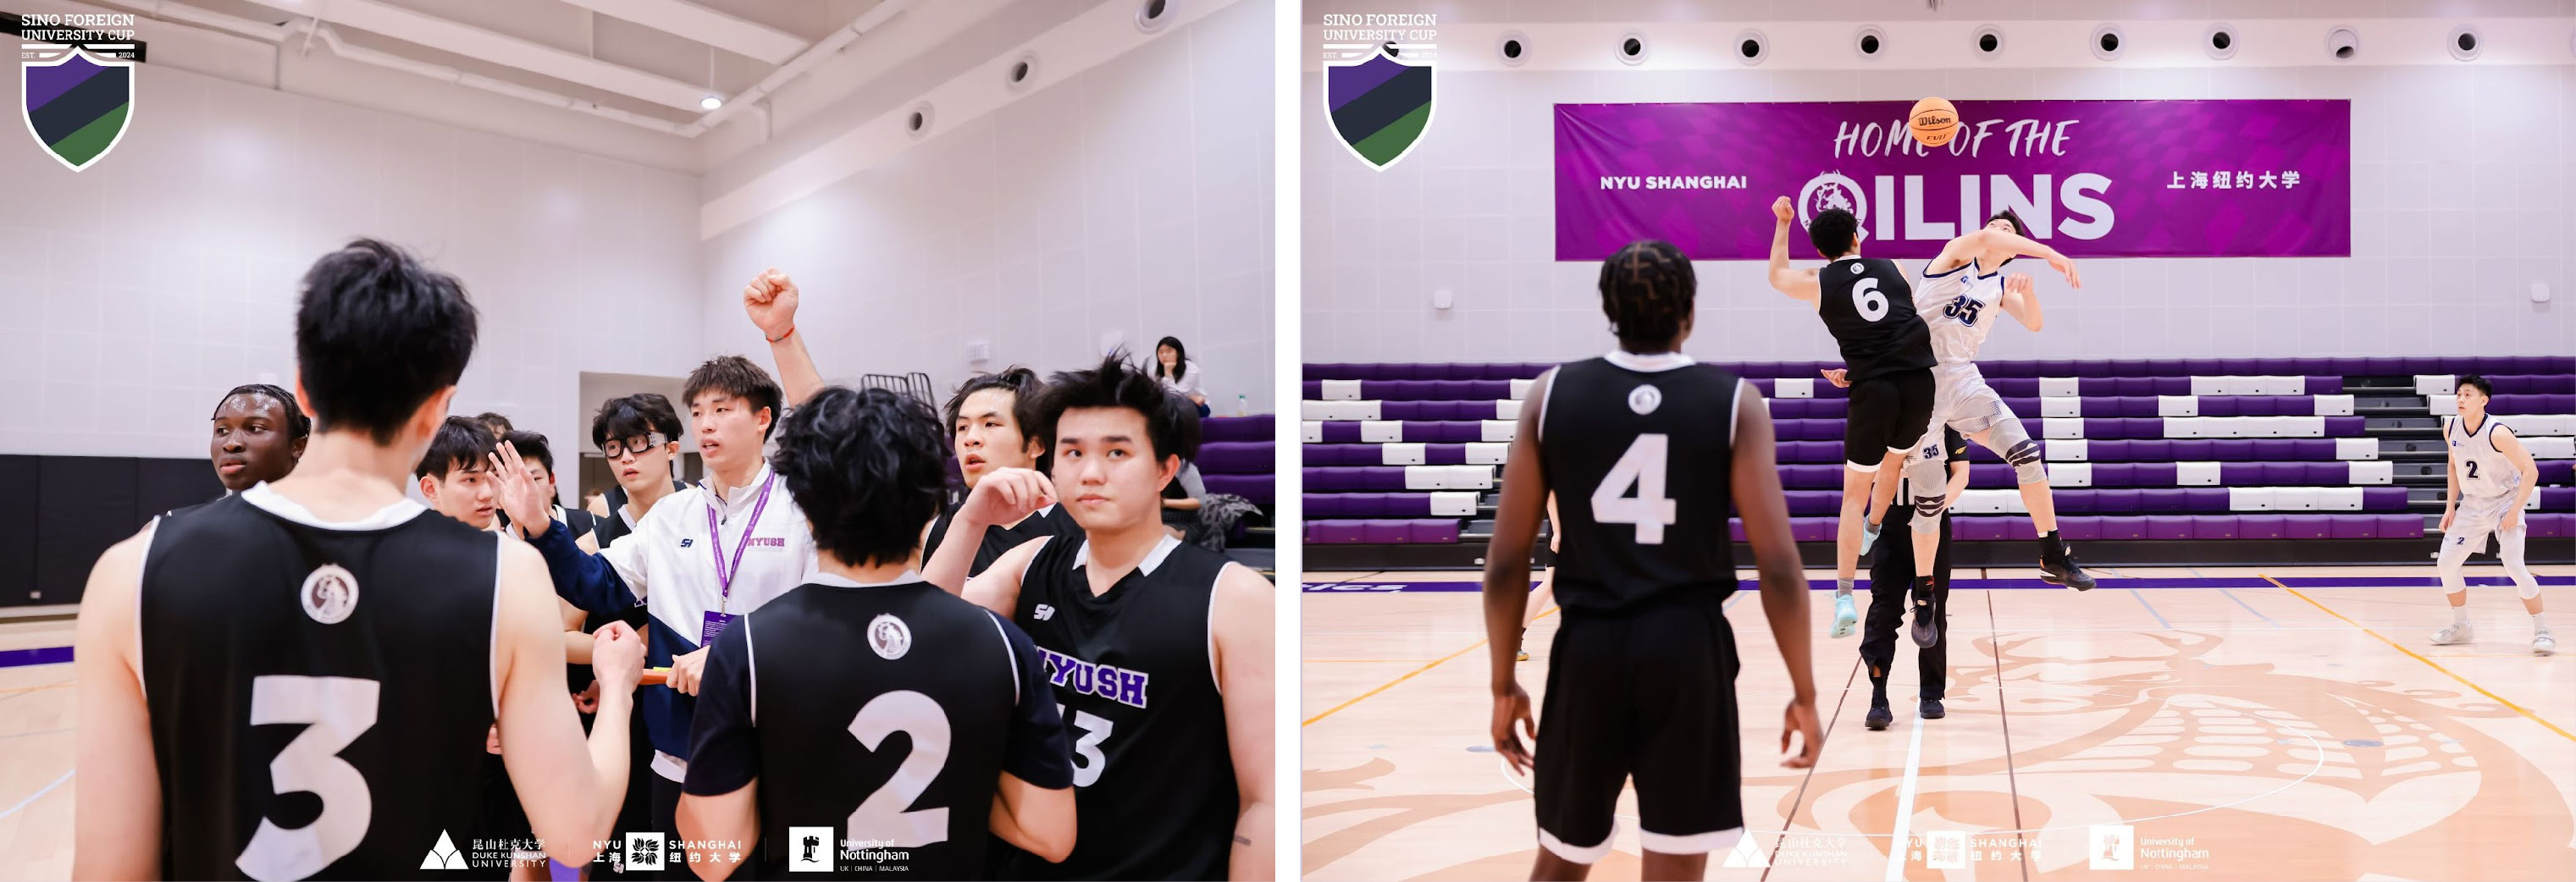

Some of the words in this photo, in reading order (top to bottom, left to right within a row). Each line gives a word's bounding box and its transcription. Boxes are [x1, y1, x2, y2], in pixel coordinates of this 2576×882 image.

[1918, 115, 1951, 126] Wilson
[1948, 119, 2005, 158] OF
[2005, 119, 2080, 157] THE
[1600, 176, 1641, 190] NYU
[1645, 175, 1748, 190] SHANGHAI
[2166, 170, 2301, 190] 上海纽约大学
[1797, 171, 2115, 243] QILINS
[1852, 278, 1889, 322] 6
[1943, 294, 1987, 327] 35
[1923, 444, 1939, 459] 35
[2465, 460, 2480, 480] 2
[1591, 433, 1677, 545] 4
[748, 537, 785, 547] NYUSH
[2456, 537, 2465, 545] 2
[1056, 703, 1114, 787] 3
[235, 675, 380, 881] 3
[847, 690, 951, 852] 2
